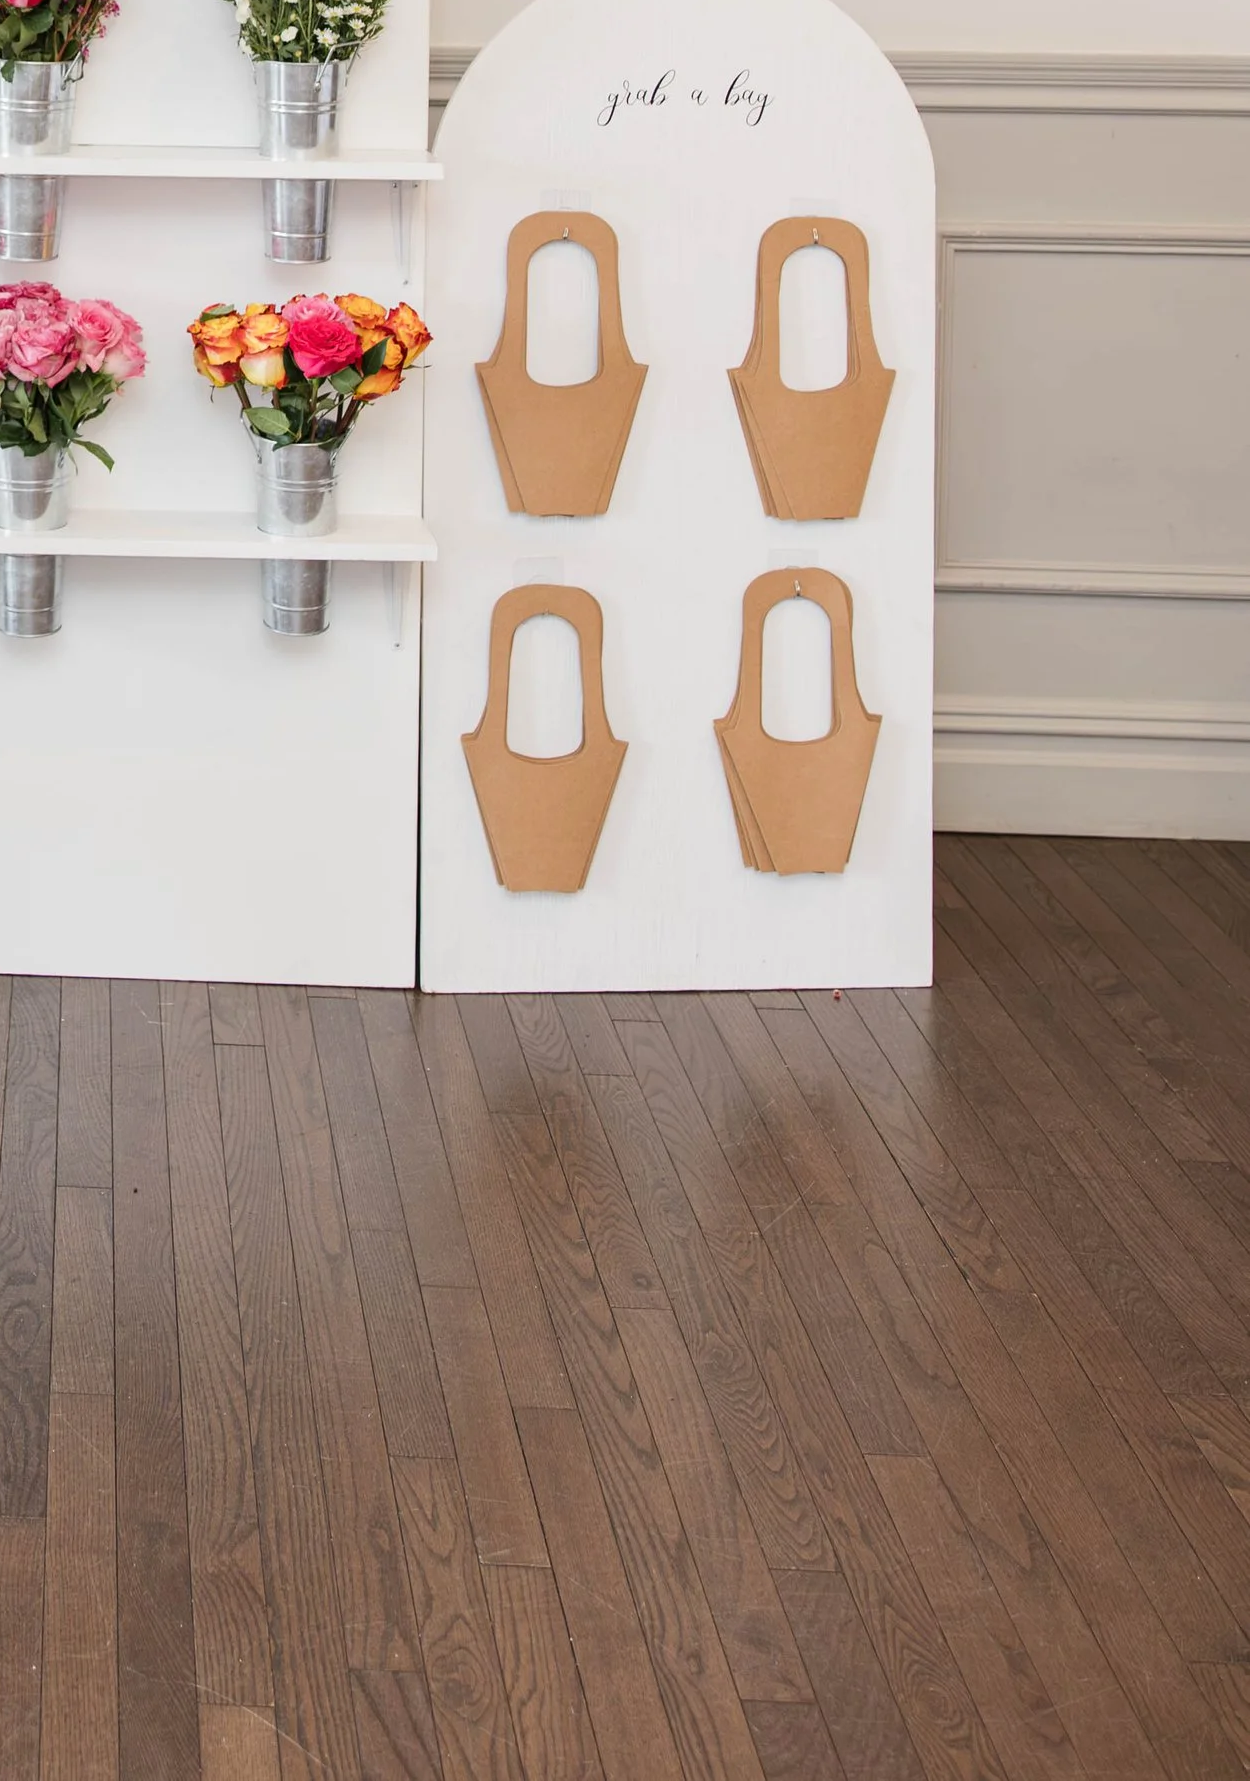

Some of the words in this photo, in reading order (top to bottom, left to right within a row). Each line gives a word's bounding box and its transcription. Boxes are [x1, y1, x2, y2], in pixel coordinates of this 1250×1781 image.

[597, 69, 676, 126] grab
[690, 88, 709, 106] a
[724, 69, 776, 126] bag
